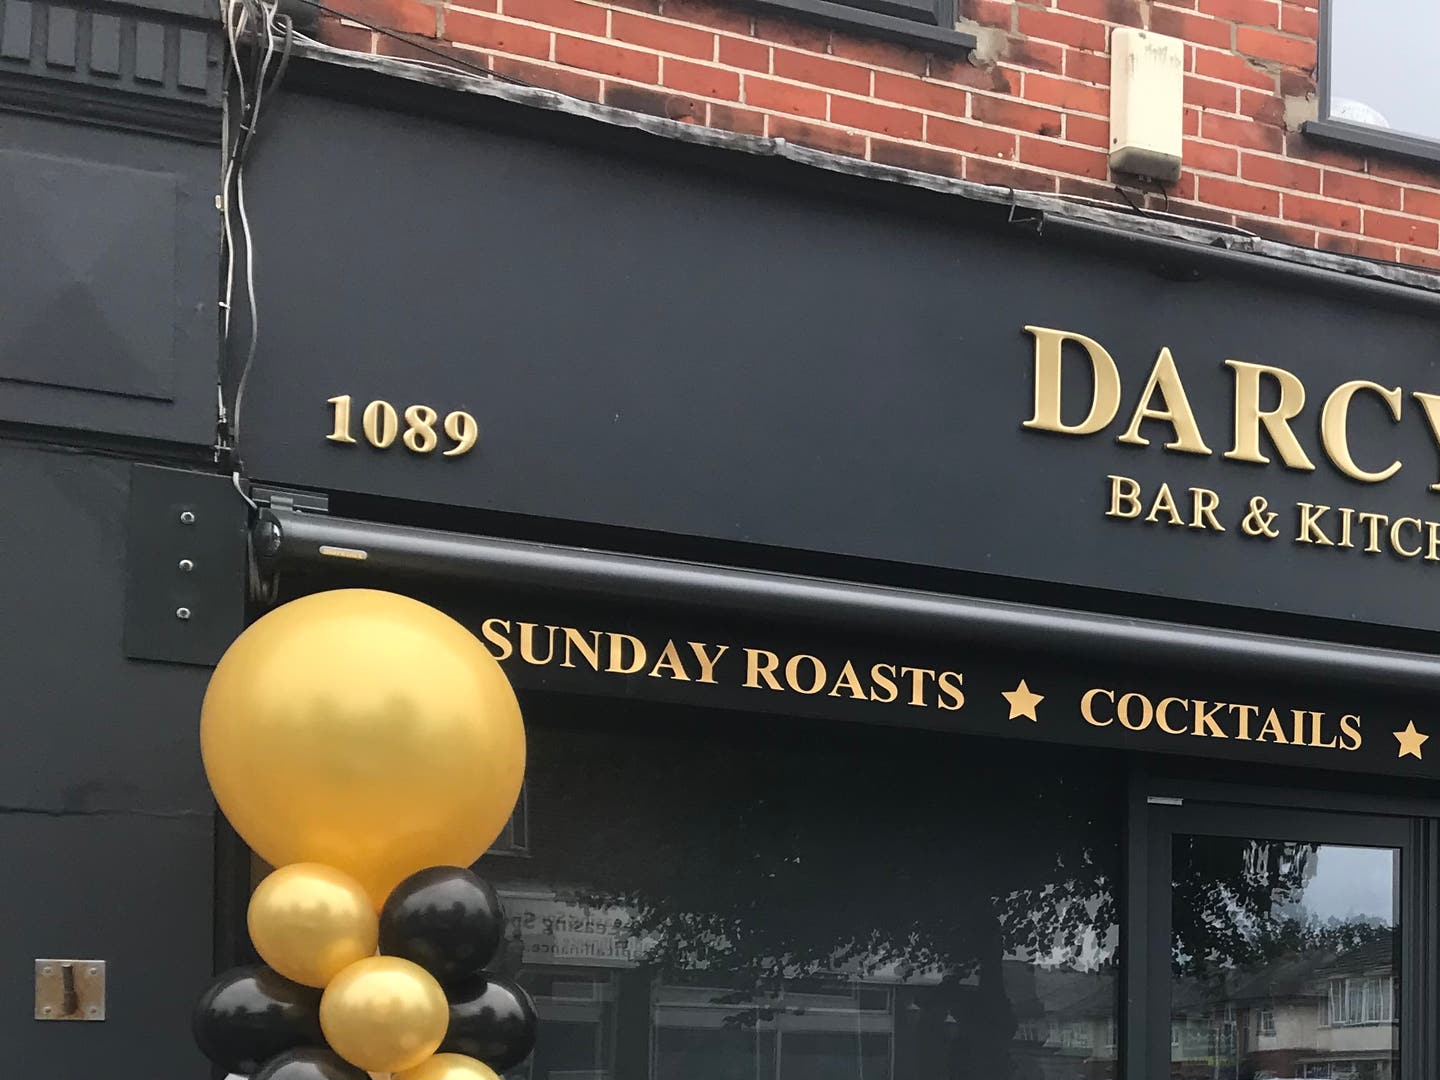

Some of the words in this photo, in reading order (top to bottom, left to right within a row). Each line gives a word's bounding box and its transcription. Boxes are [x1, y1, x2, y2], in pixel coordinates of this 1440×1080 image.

[326, 394, 478, 456] 1089
[1106, 475, 1224, 532] BAR
[1241, 496, 1279, 538] &
[482, 618, 728, 684] SUNDAY
[742, 648, 965, 711] ROASTS
[1080, 688, 1362, 752] COCKTAILS
